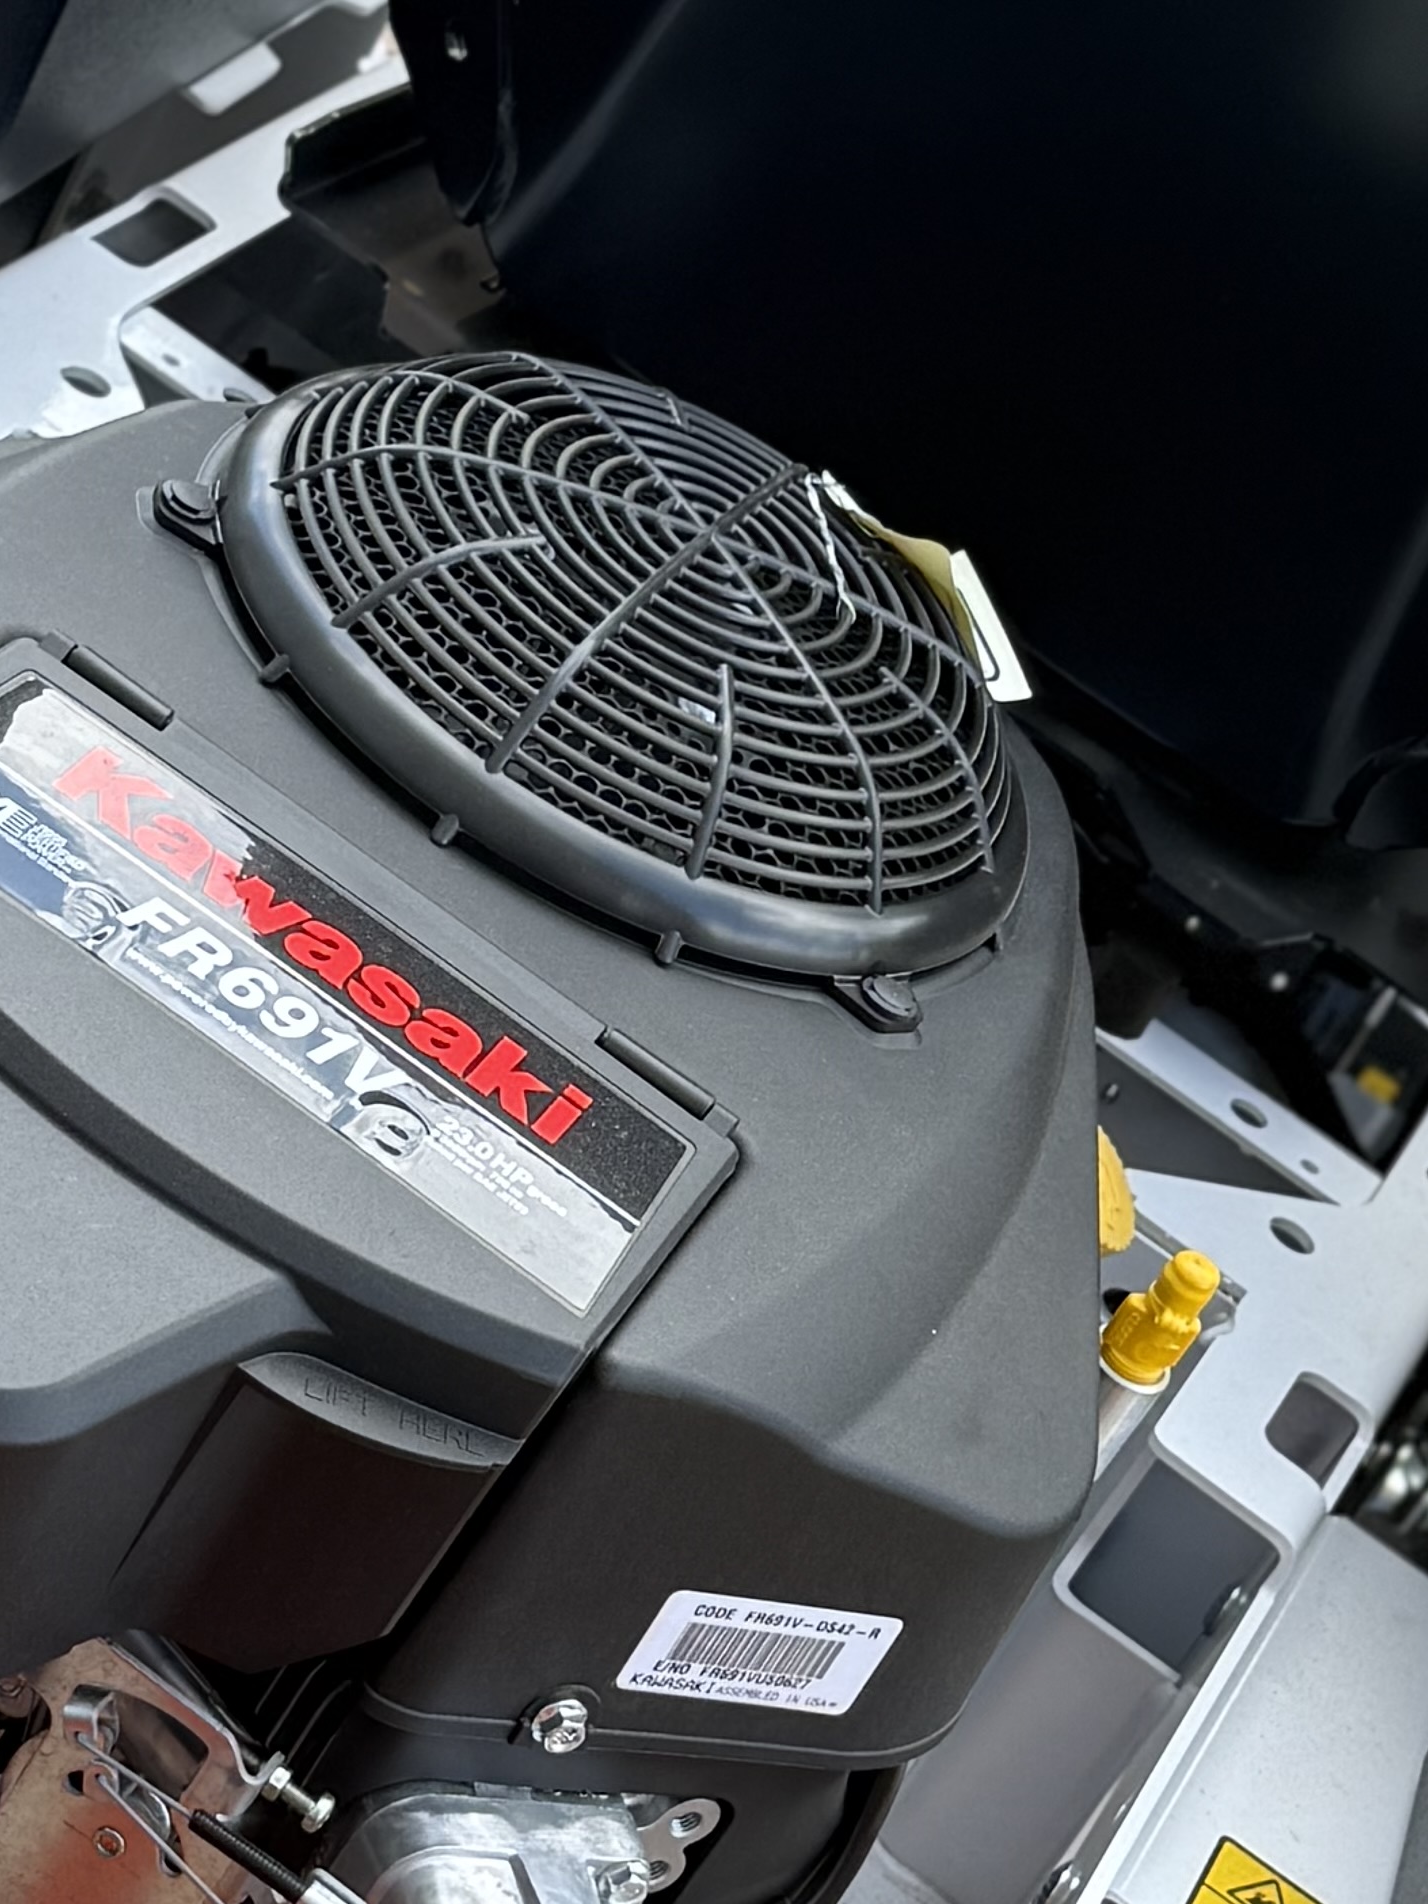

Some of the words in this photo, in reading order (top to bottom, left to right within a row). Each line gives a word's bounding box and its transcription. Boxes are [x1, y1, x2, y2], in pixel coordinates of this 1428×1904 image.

[51, 746, 594, 1145] Kawasaki
[115, 896, 413, 1095] FR691V
[436, 1114, 491, 1159] 23.0
[488, 1151, 535, 1188] HP
[303, 1377, 372, 1417] LIFT
[693, 1604, 738, 1621] CODE
[628, 1672, 717, 1694] KAWASAKI
